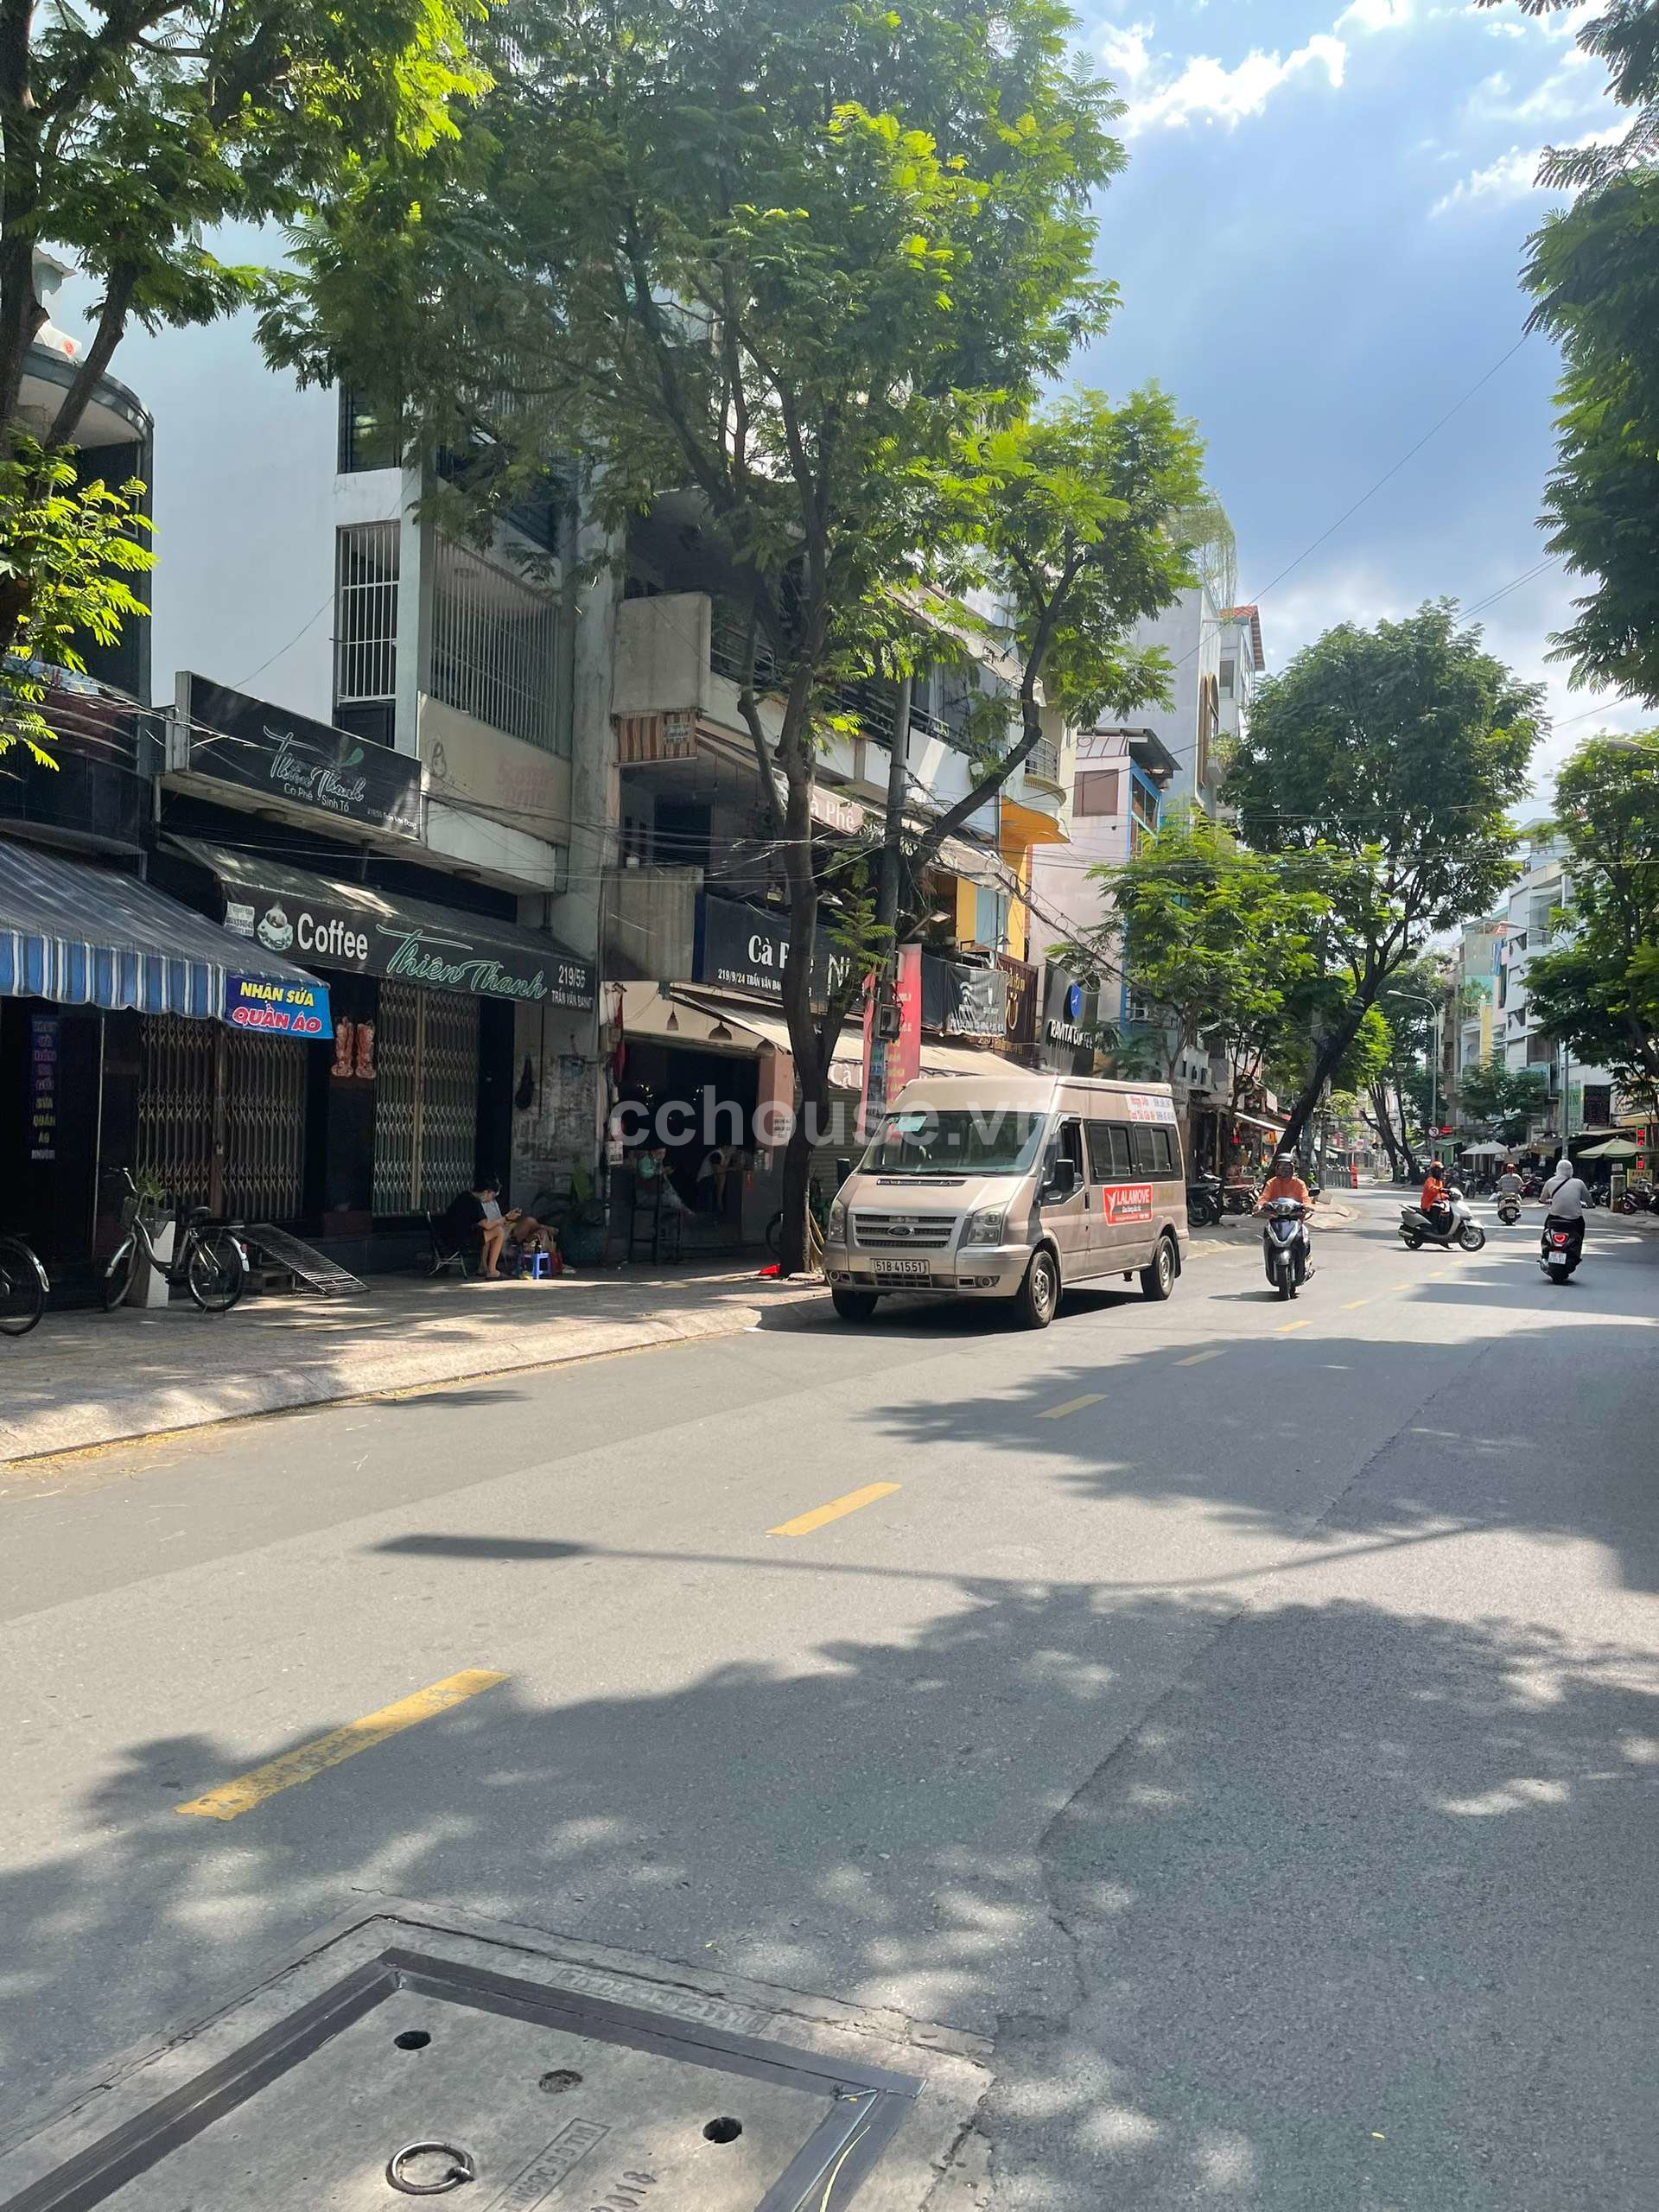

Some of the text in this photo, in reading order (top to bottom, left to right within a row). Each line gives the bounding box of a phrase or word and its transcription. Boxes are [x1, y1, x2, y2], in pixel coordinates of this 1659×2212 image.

[321, 794, 338, 810] Sinh
[826, 800, 855, 832] Phê
[297, 912, 368, 960] Coffee
[376, 924, 548, 999] Thiên Thanh
[748, 935, 773, 967] Cà
[558, 964, 586, 988] 219/55
[240, 982, 314, 1007] NHẬN SỬA
[232, 1003, 321, 1033] QUẦN ÁO
[830, 1064, 852, 1089] Cà
[1116, 1188, 1150, 1205] LALAMOVE
